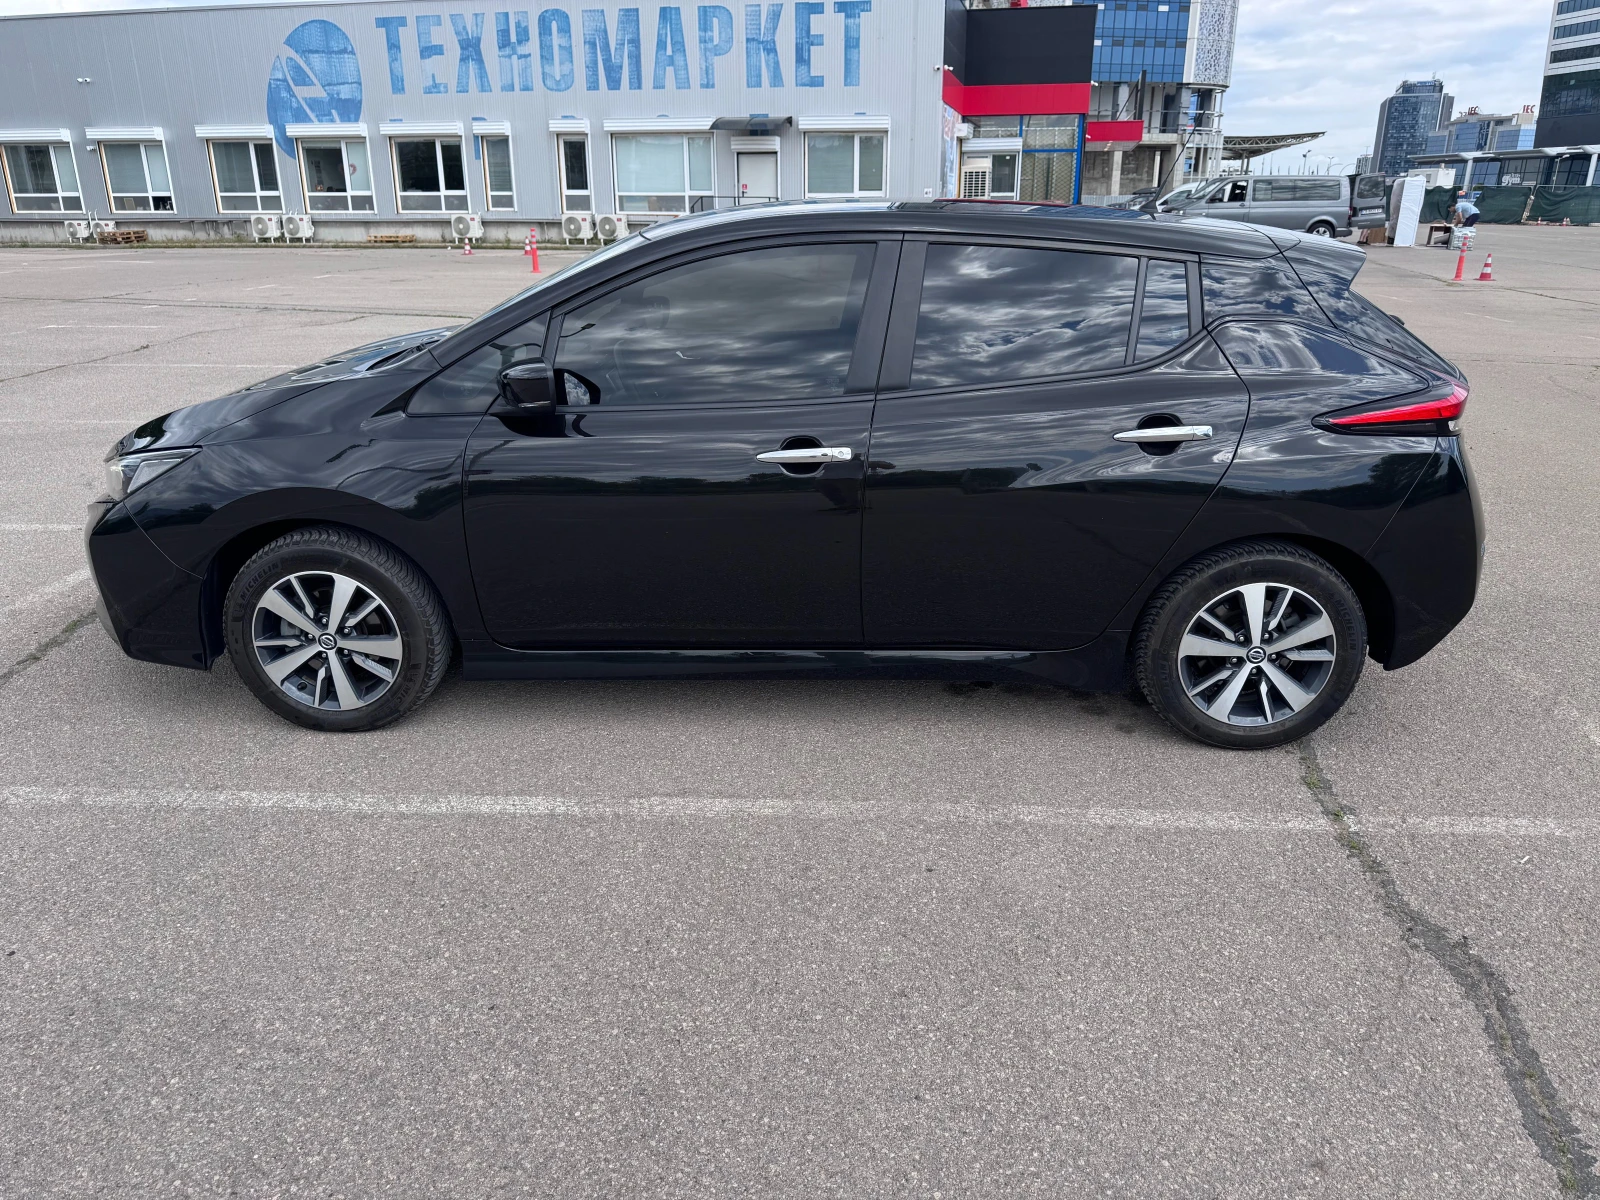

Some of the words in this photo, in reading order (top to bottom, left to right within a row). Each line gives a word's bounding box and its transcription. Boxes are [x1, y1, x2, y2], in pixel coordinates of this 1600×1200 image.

[375, 0, 872, 95] ТЕХНОМАРКЕТ
[1523, 104, 1535, 114] IEC
[240, 562, 279, 601] MICHELIN
[1335, 598, 1356, 651] MICHELIN
